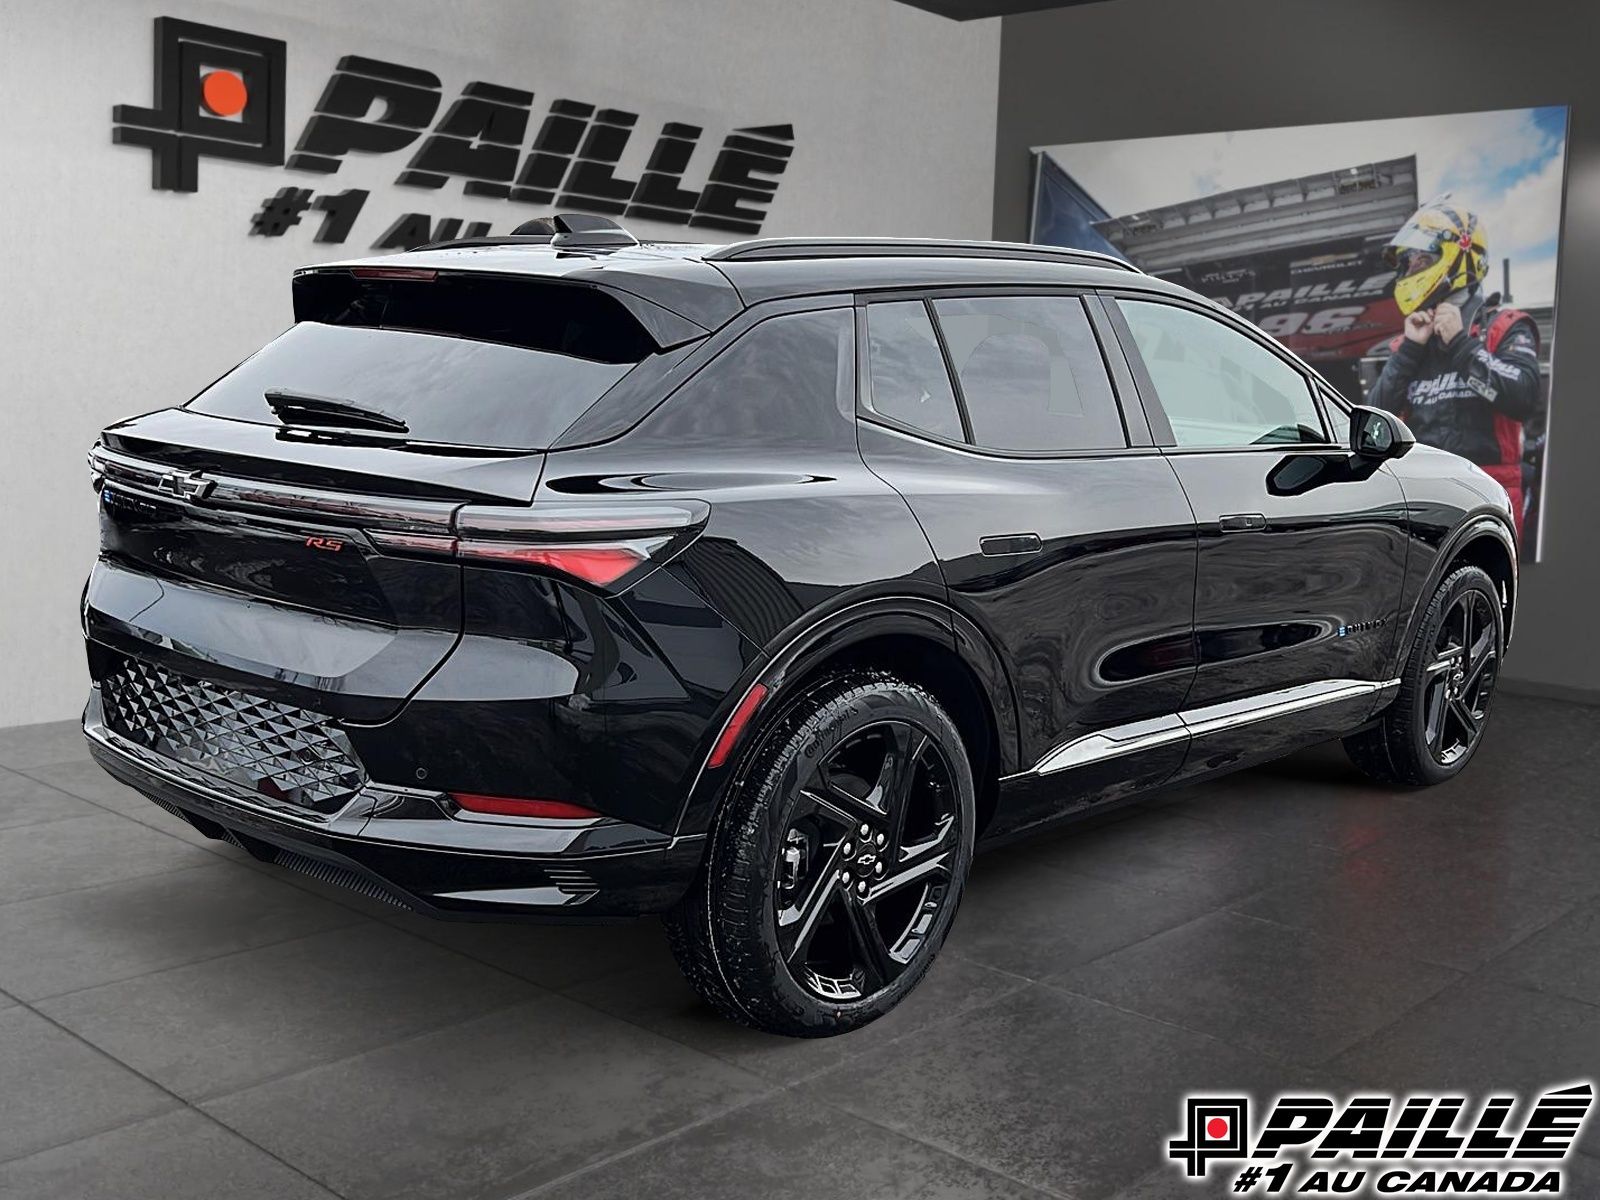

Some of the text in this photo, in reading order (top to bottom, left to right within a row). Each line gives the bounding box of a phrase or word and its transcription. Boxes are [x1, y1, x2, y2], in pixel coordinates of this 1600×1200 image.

[285, 55, 795, 235] PAILLÉ
[248, 186, 371, 243] #1
[1258, 306, 1366, 337] 96
[306, 535, 343, 551] RS
